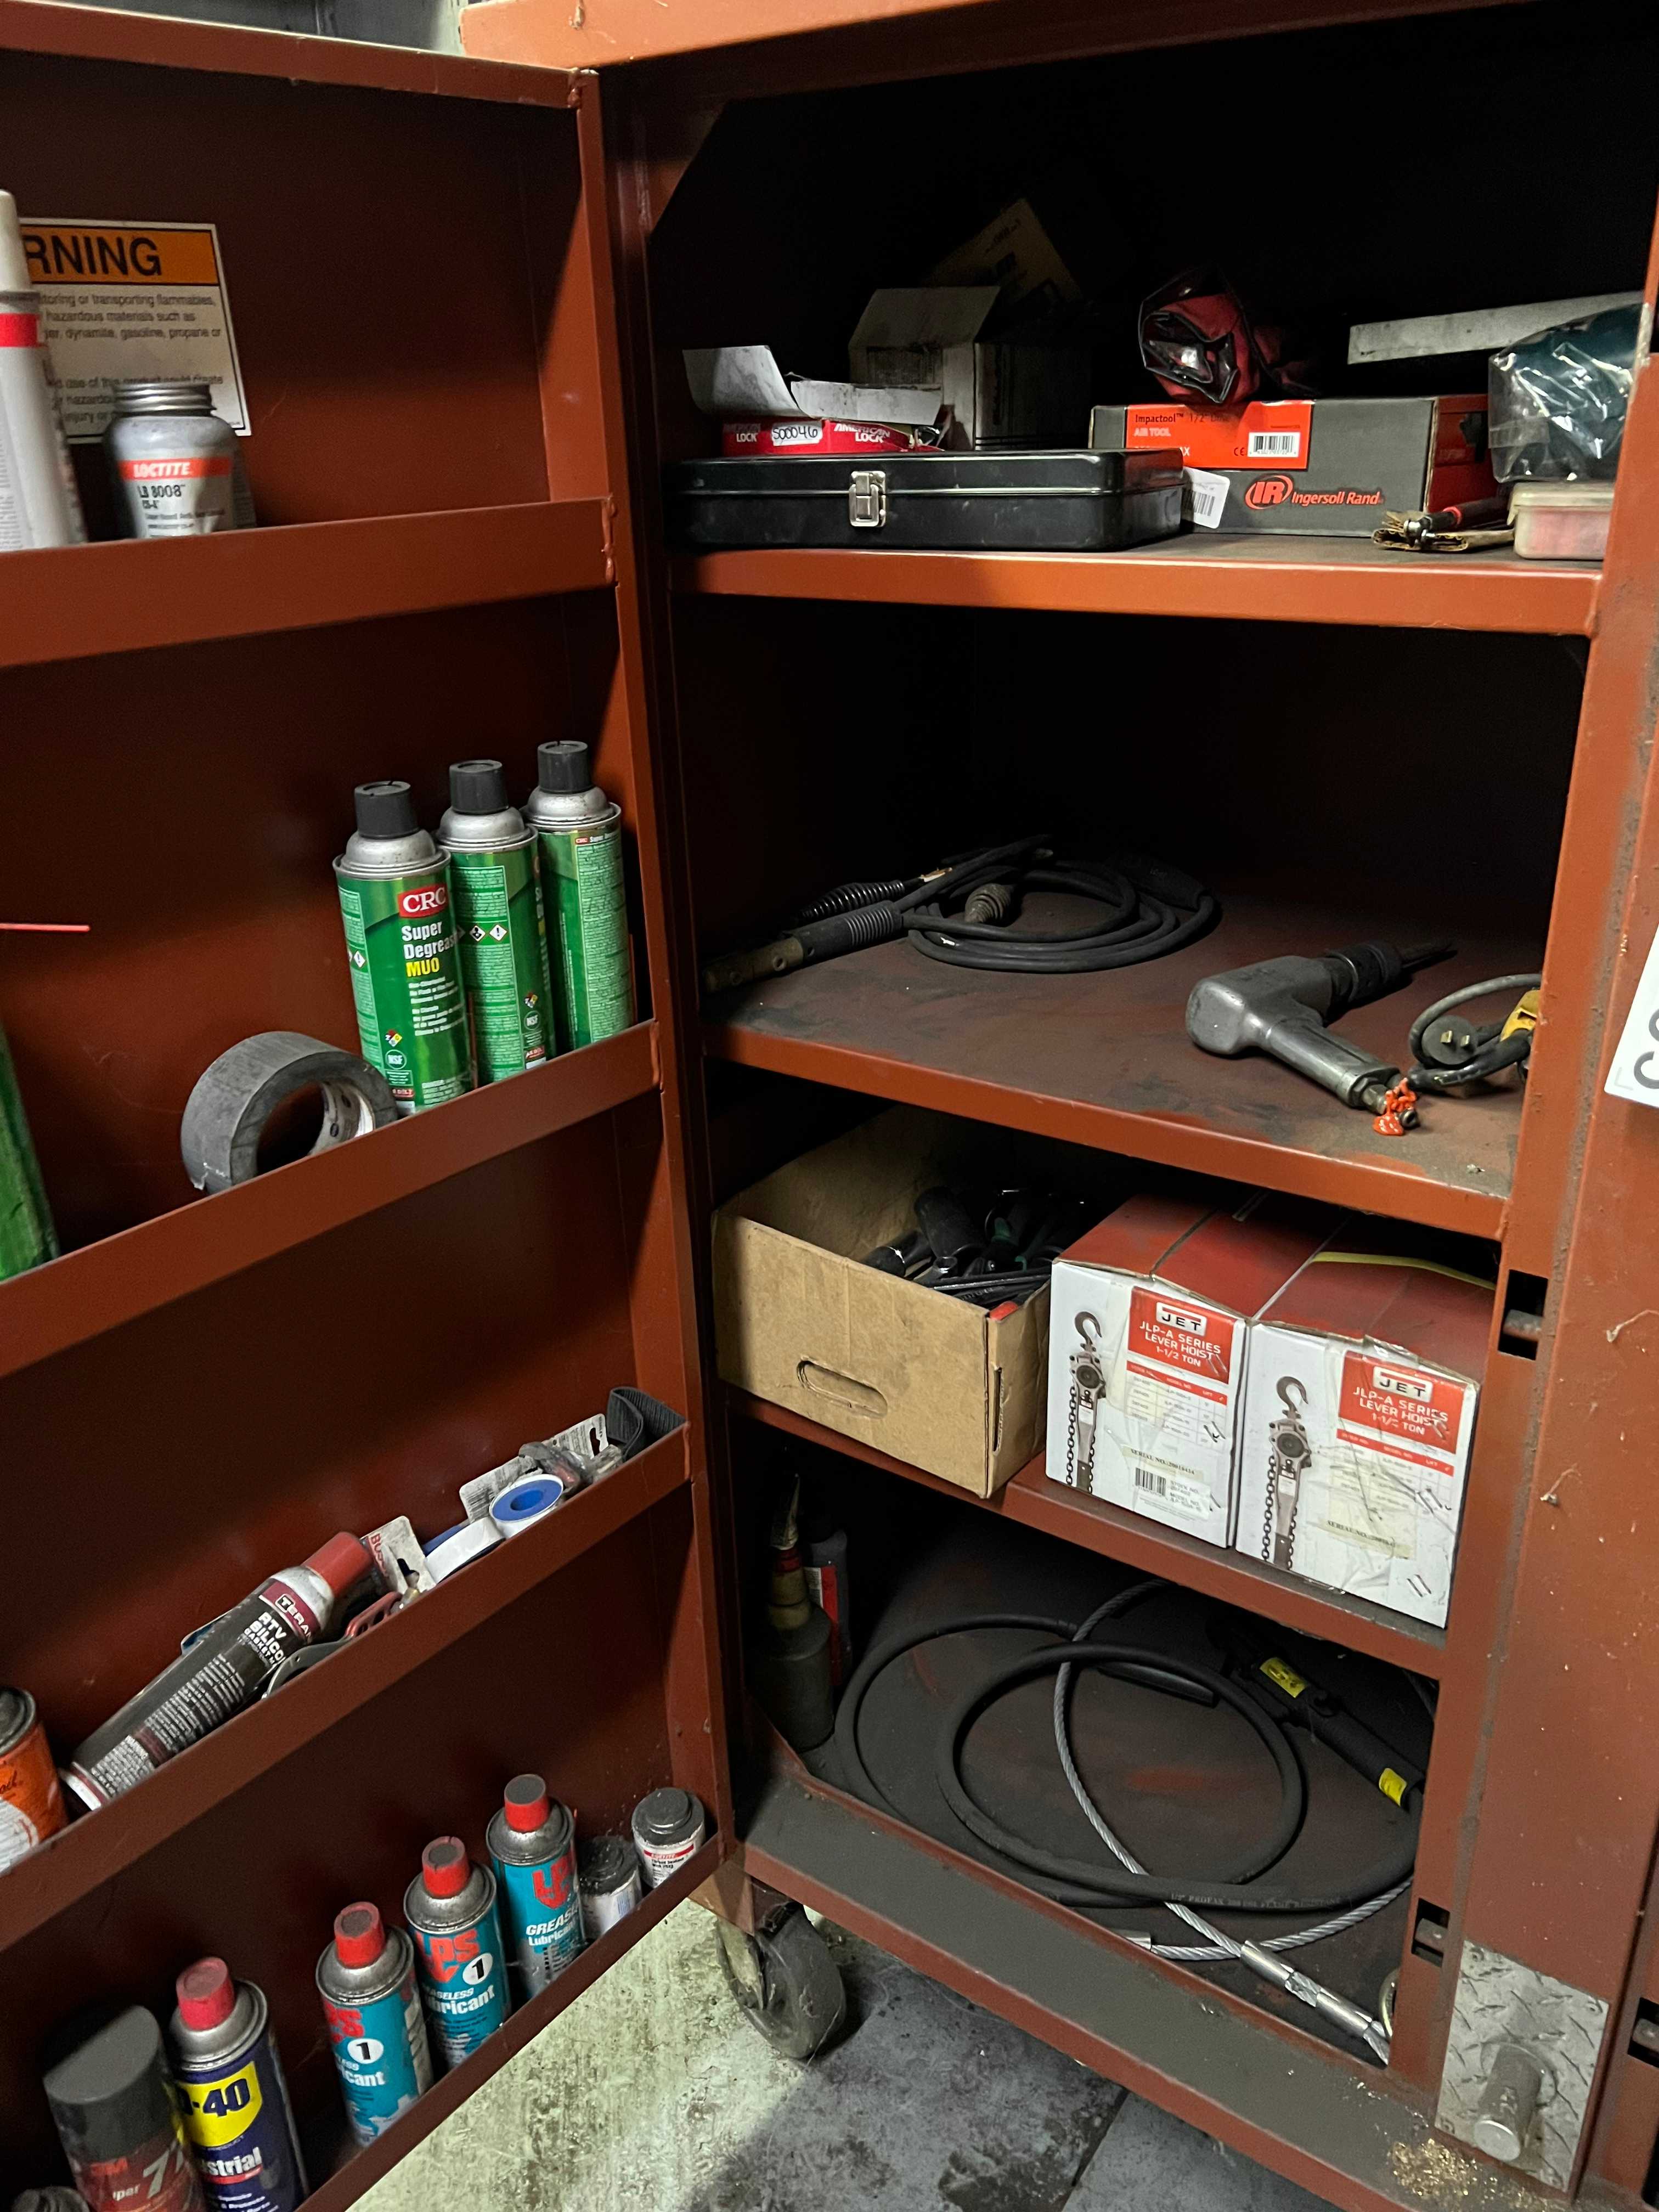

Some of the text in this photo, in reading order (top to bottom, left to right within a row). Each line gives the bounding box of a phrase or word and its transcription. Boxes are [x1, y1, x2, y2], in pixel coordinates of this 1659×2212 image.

[22, 235, 162, 275] RNING
[737, 432, 757, 442] LOCK
[133, 461, 191, 478] LOCTITE
[1291, 491, 1345, 506] Ingersoll
[403, 887, 446, 913] CRC
[402, 921, 442, 941] Super
[406, 957, 440, 977] MUO
[1162, 1314, 1201, 1331] JET
[1139, 1321, 1221, 1354] JLP-A SERIES
[1145, 1331, 1212, 1360] LEVER HOIST
[1182, 1355, 1201, 1367] TON
[1379, 1379, 1426, 1397] JET
[1353, 1386, 1448, 1422] JLP-A SERIES
[1359, 1397, 1439, 1426] LEVER HOIST
[1402, 1422, 1425, 1435] TON
[258, 1612, 287, 1639] RTV
[249, 1621, 286, 1661] SILICO
[472, 1958, 484, 1979] 1
[356, 2042, 371, 2060] 1
[207, 2147, 263, 2177] strial
